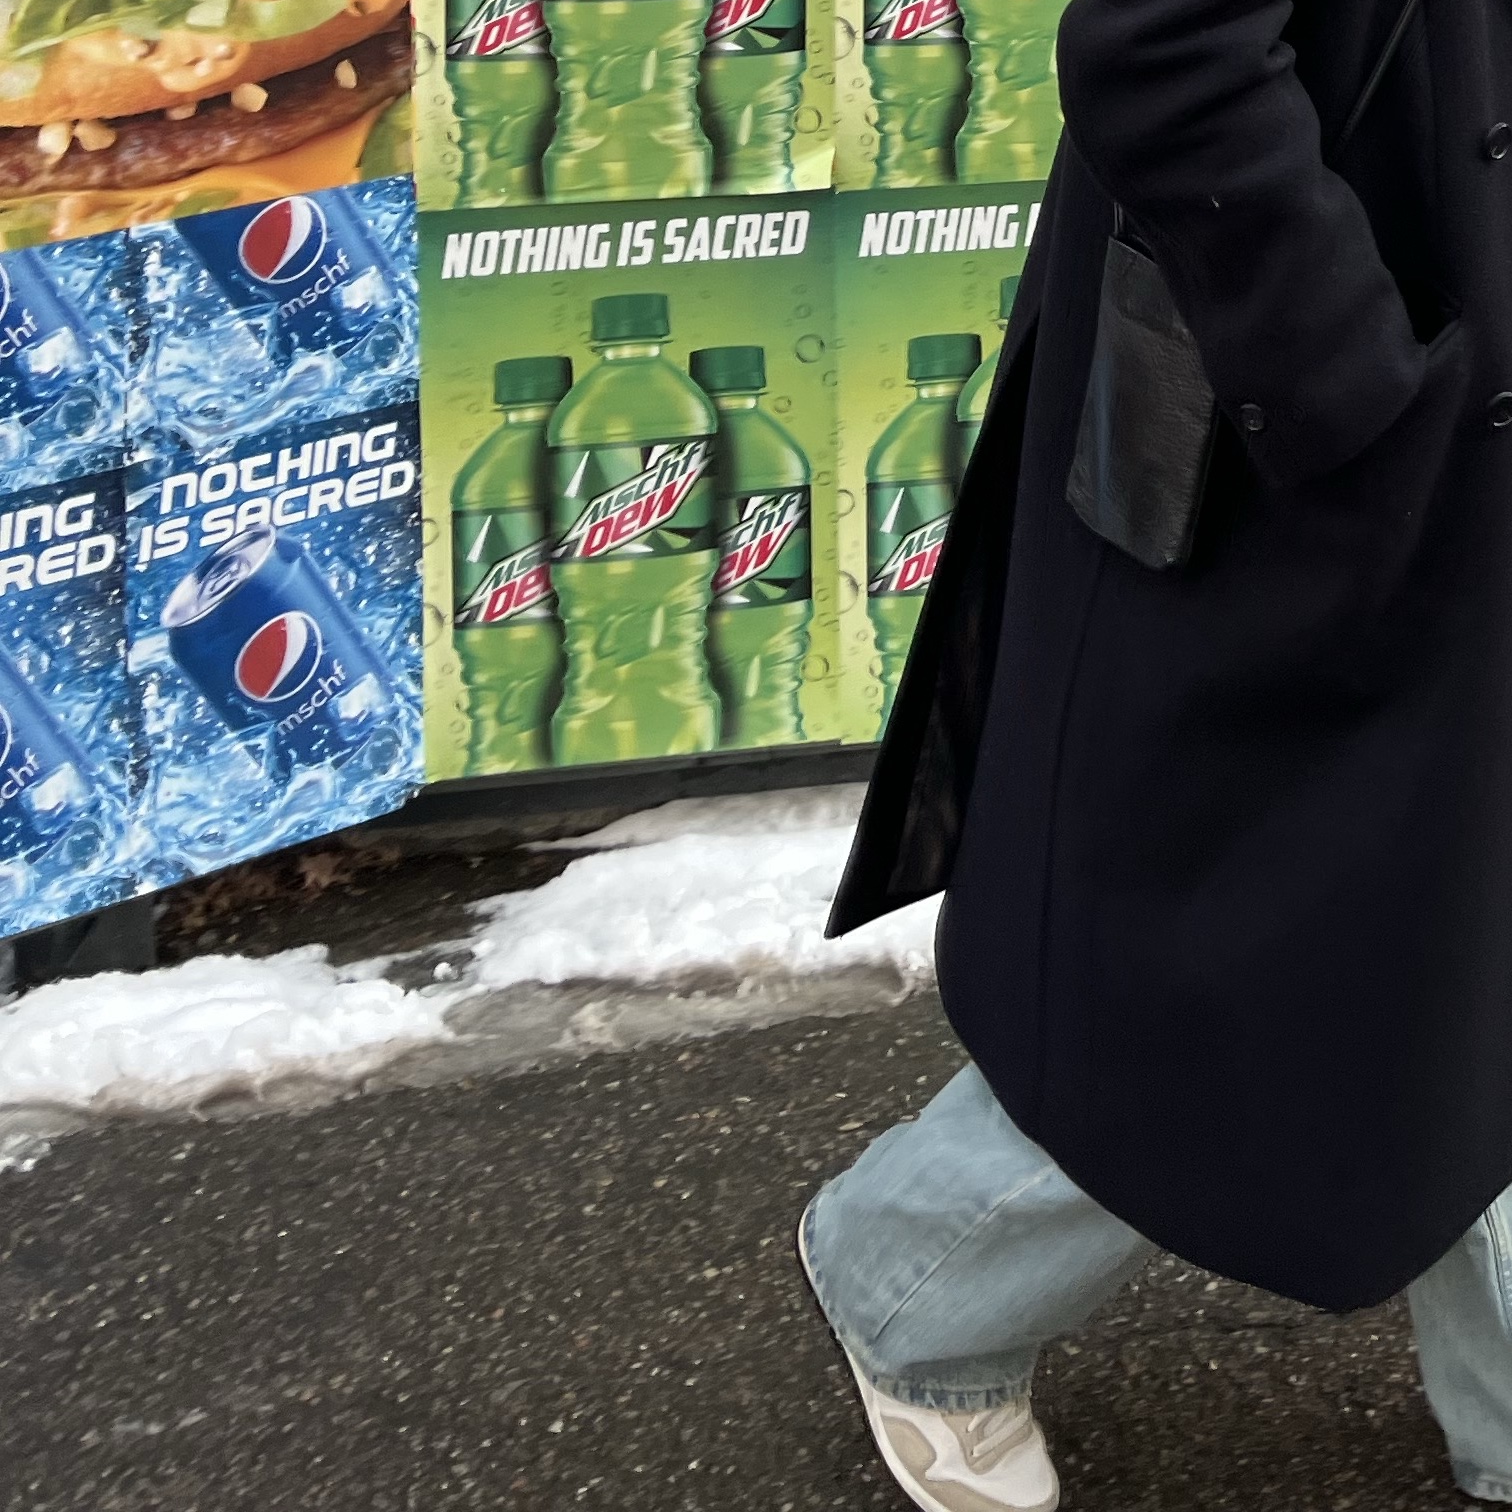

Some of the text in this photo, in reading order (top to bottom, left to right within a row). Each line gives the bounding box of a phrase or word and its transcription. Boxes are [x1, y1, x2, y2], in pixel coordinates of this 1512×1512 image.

[442, 211, 811, 279] NOTHING IS SACRED
[858, 204, 1020, 258] NOTHING
[137, 460, 416, 566] IS SACRED
